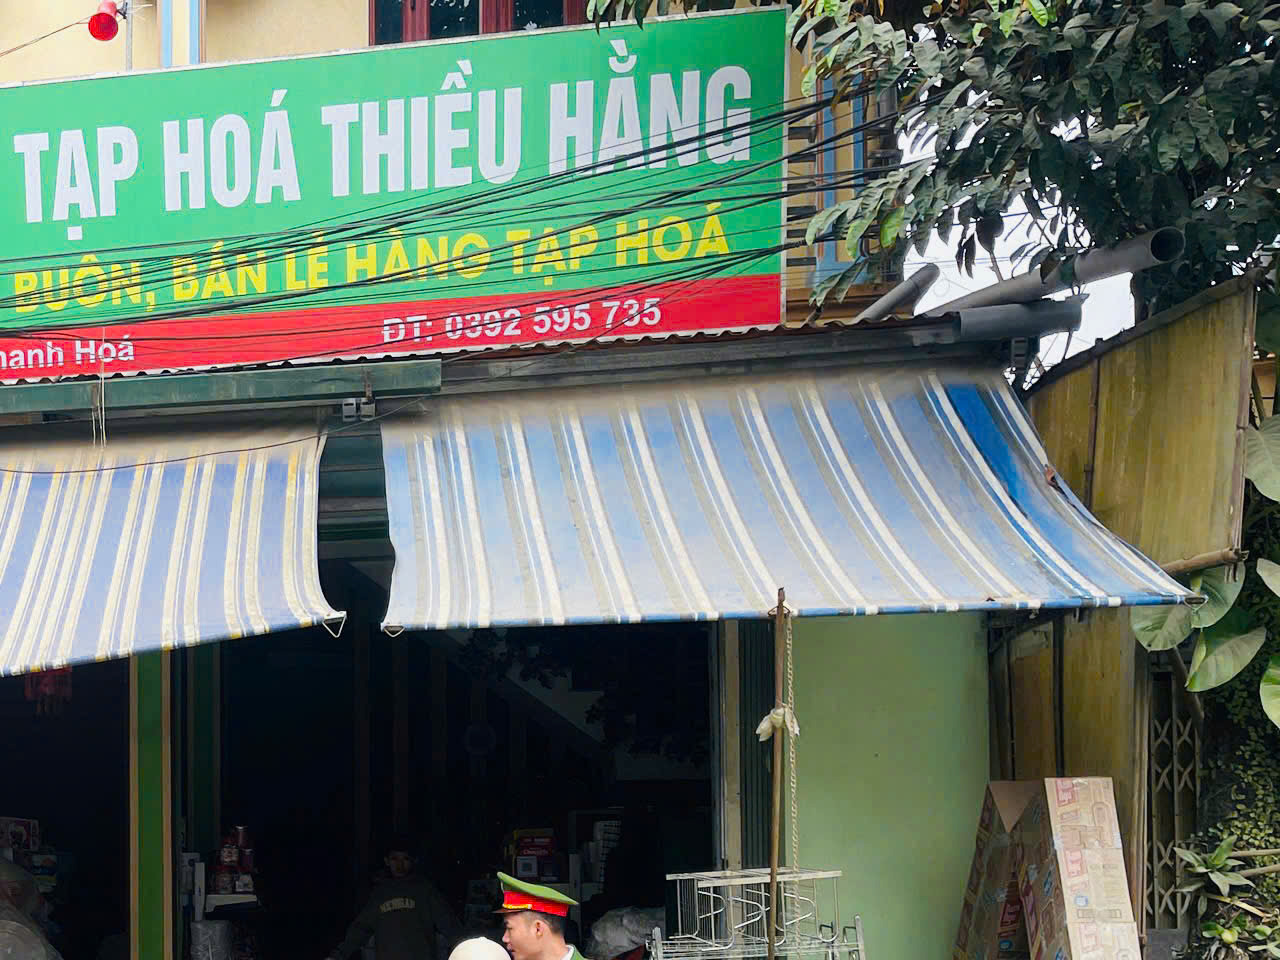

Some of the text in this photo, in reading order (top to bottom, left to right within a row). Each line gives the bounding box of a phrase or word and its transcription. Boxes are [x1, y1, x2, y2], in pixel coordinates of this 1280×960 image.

[14, 125, 139, 241] TẠP
[162, 89, 301, 212] HOÁ
[321, 59, 522, 197] THIỀU
[549, 39, 752, 176] HẰNG
[14, 254, 155, 313] BUÔN,
[172, 240, 268, 301] BÁN
[506, 226, 599, 285] TẠP
[615, 203, 732, 265] HOÁ
[74, 334, 135, 366] Hoá
[380, 297, 662, 344] ĐT: 0392 595 735
